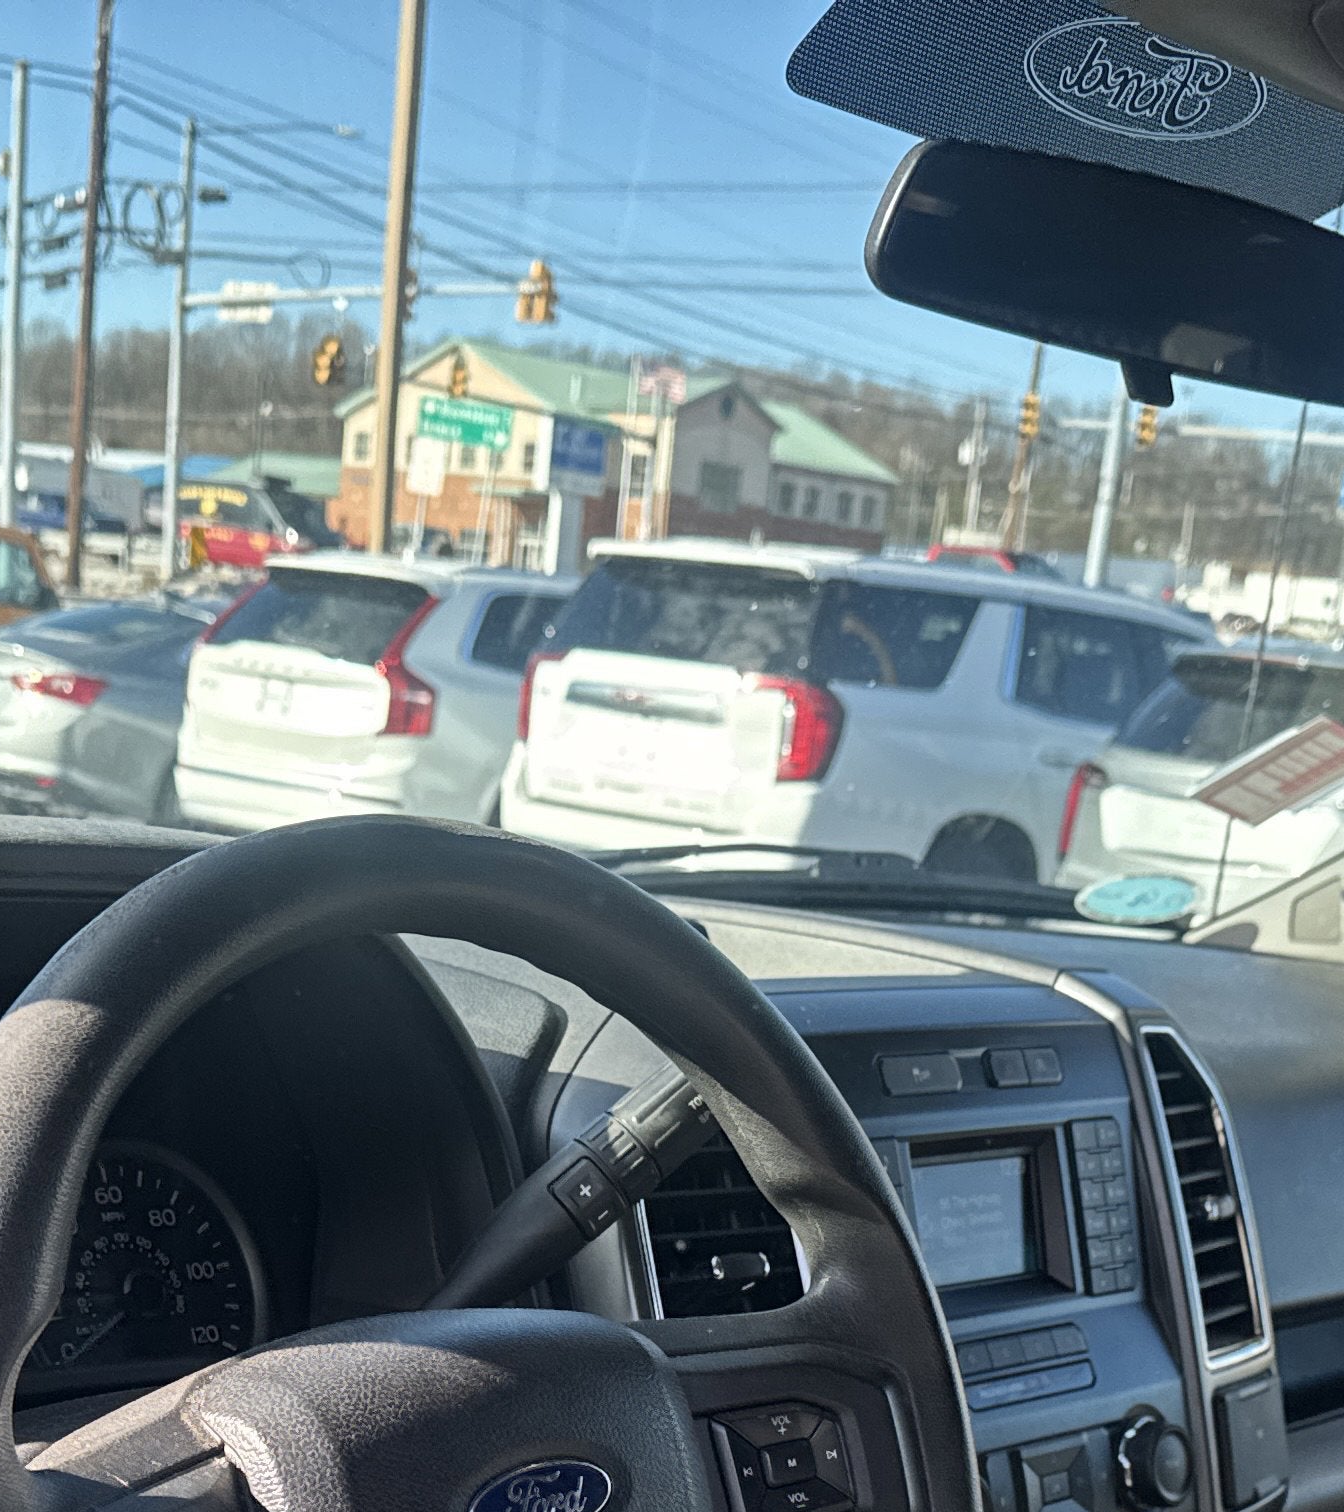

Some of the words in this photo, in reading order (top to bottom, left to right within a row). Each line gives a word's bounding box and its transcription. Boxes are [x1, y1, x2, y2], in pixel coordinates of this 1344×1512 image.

[94, 1186, 122, 1204] 60
[148, 1208, 176, 1227] 80
[186, 1261, 215, 1280] 100
[191, 1325, 219, 1344] 120
[771, 1415, 792, 1426] VOL
[788, 1492, 809, 1503] VOL
